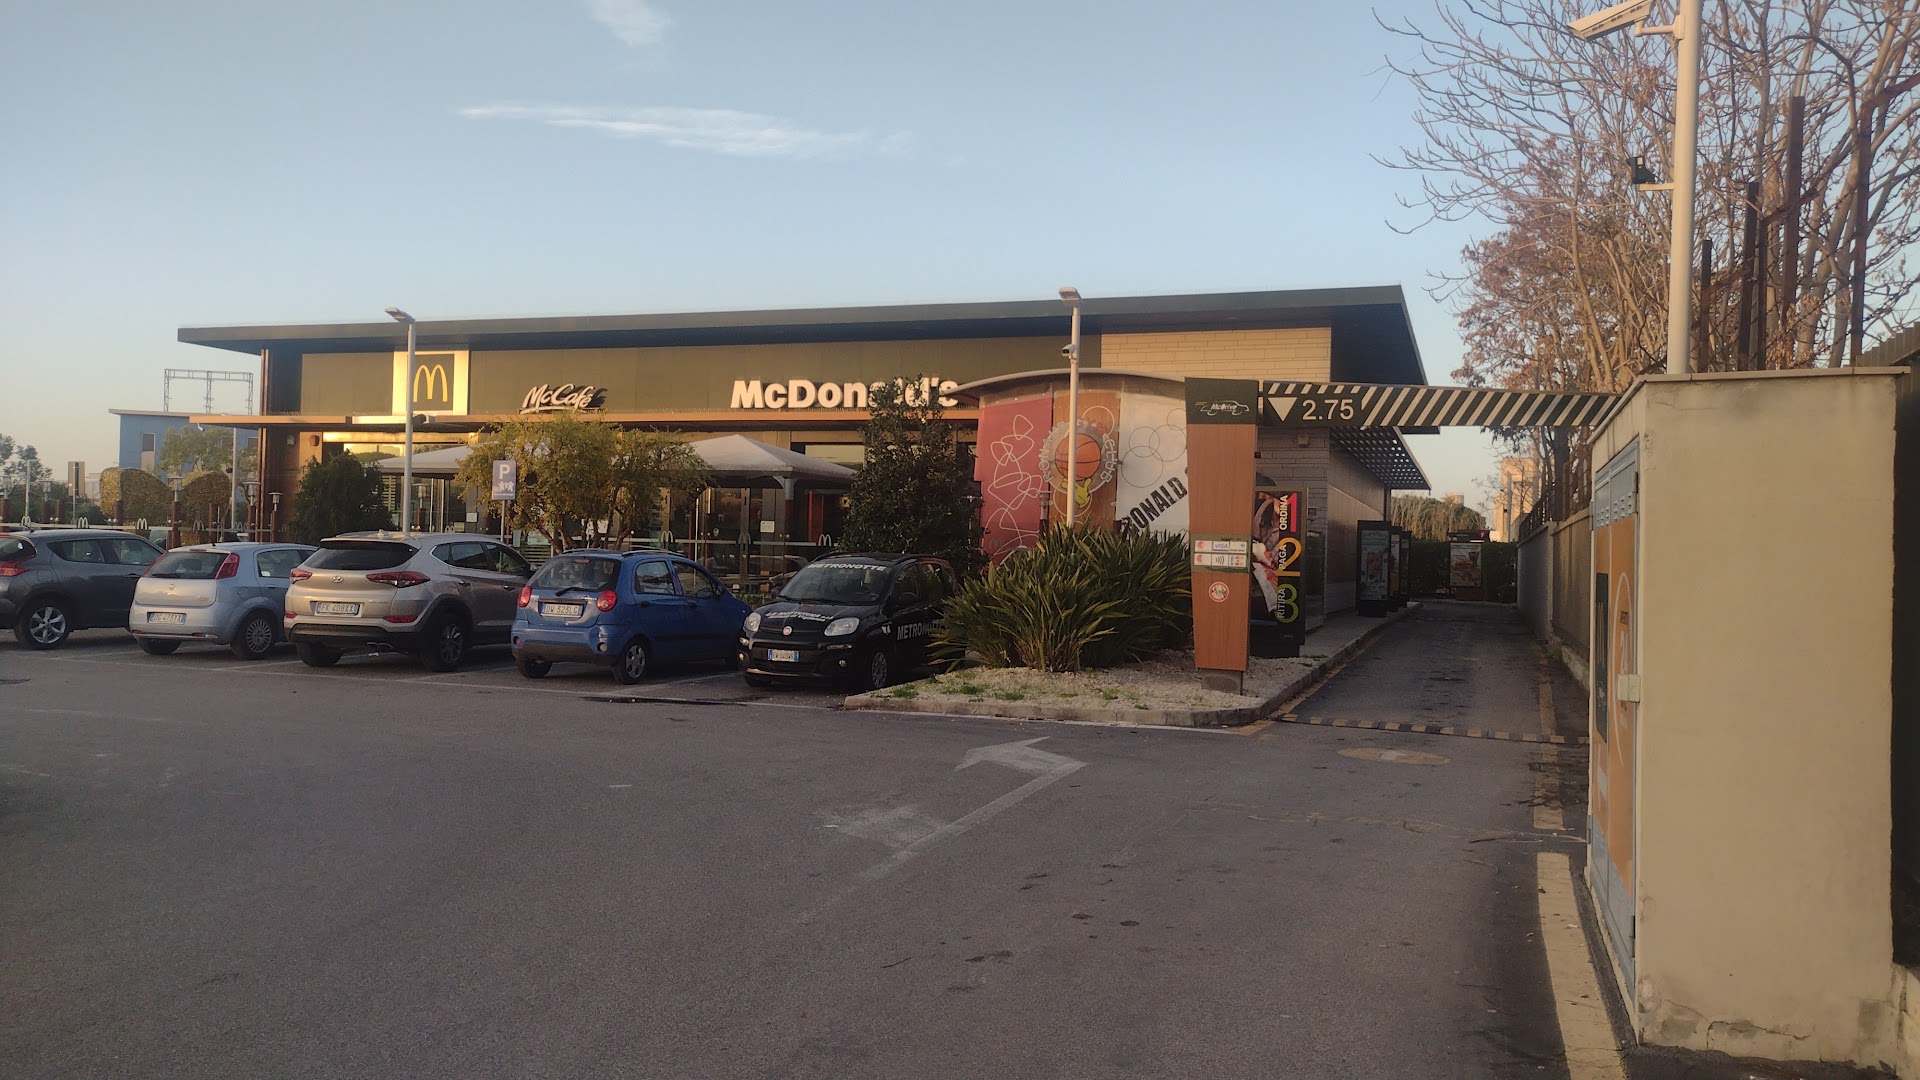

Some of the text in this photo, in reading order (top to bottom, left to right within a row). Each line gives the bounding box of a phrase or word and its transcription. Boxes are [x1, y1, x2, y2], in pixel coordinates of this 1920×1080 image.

[1302, 399, 1354, 420] 2.75
[499, 464, 511, 480] P
[1279, 495, 1288, 531] ORDINA
[807, 563, 887, 572] METRONOTTE
[1276, 537, 1302, 577] 2
[1277, 588, 1286, 619] RITIRA
